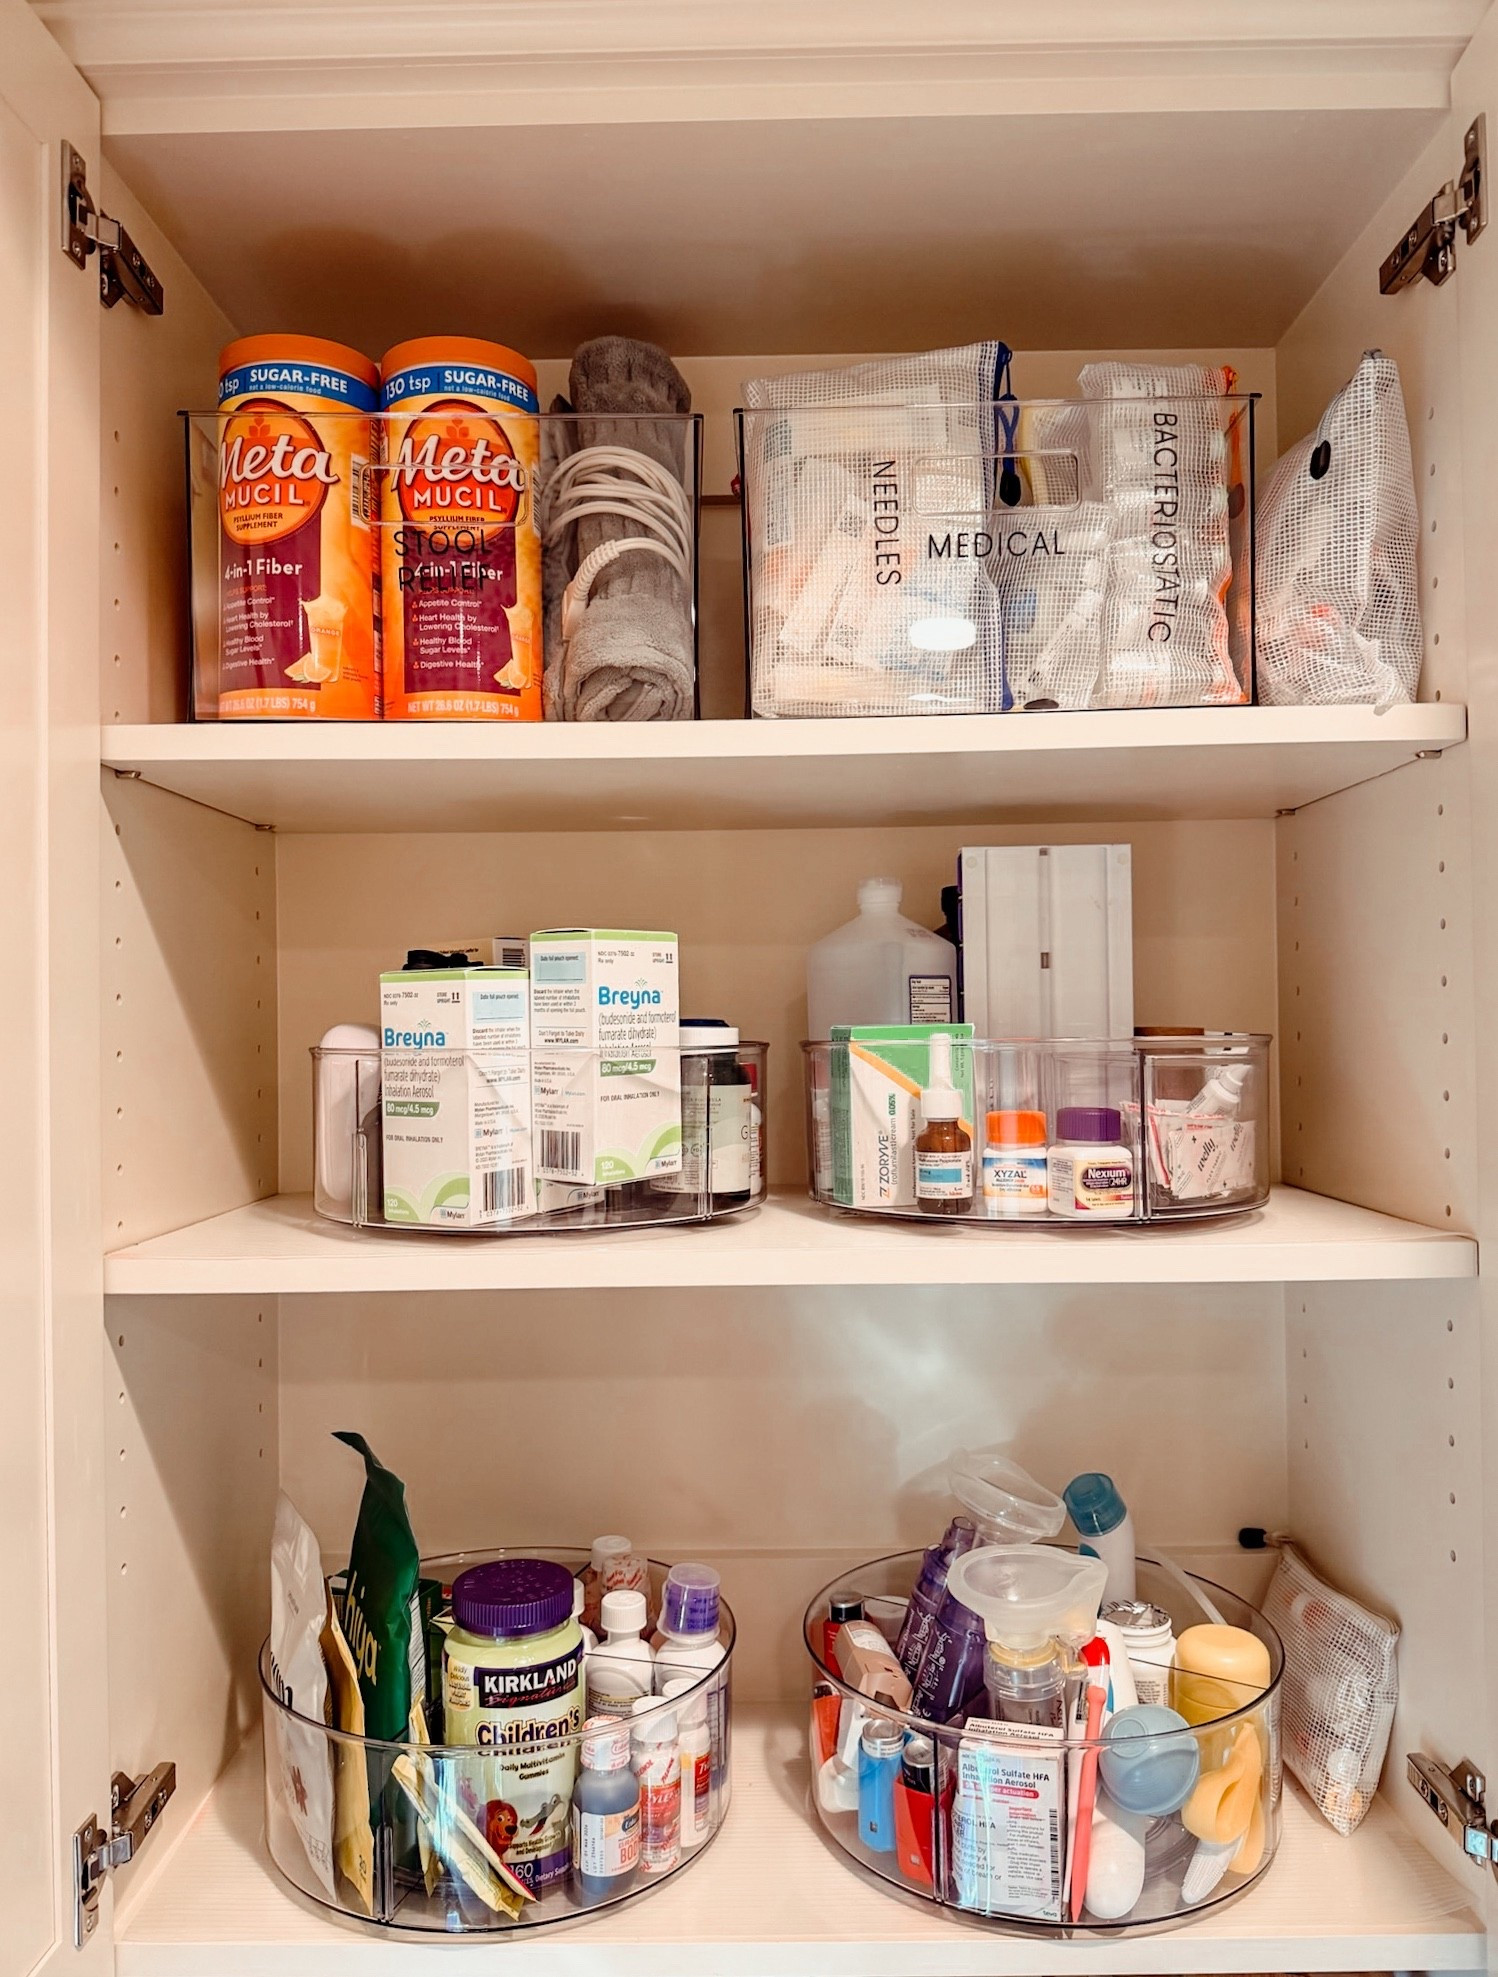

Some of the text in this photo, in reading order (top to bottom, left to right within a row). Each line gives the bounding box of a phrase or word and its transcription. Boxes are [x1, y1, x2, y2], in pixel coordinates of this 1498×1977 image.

[225, 378, 240, 396] tsp
[250, 368, 348, 394] SUGAR-FREE
[386, 375, 431, 401] 130 tsp
[444, 371, 529, 403] SUGAR-FREE
[221, 434, 341, 490] Meta
[391, 434, 526, 492] Meta
[225, 484, 305, 510] MUCIL
[413, 487, 503, 512] MUCIL
[263, 513, 284, 524] FIBER
[872, 460, 901, 585] NEEDLES
[235, 520, 279, 534] SUPPLEMENT
[1148, 412, 1182, 642] BACTERIOSTATIC
[394, 528, 493, 557] STOOL
[928, 531, 1064, 561] MEDICAL
[225, 556, 303, 580] 4-in-1 Fiber
[415, 560, 505, 581] 4-in-1 Fiber
[399, 565, 490, 592] RELIEF
[419, 599, 449, 609] Appetite
[419, 614, 478, 624] Heart Health by
[311, 627, 341, 637] ORANGE
[419, 622, 456, 633] Lowering
[419, 638, 446, 648] Healthy
[420, 648, 440, 657] Sugar
[421, 660, 453, 672] Digestive
[292, 697, 308, 710] 754
[598, 986, 661, 1010] Breyna
[637, 1012, 648, 1024] and
[384, 1027, 446, 1050] Breyna
[598, 1026, 657, 1041] fumarate dihydrate)
[418, 1055, 430, 1066] and
[431, 1054, 465, 1067] formoterol
[601, 1061, 611, 1070] 80
[639, 1063, 652, 1071] mcg
[384, 1084, 434, 1098] Inhalation Aerosol
[624, 1093, 649, 1101] INHALATION
[386, 1105, 434, 1116] 80 mcg/4.5 mcg
[889, 1093, 899, 1116] 0.05%
[890, 1117, 899, 1141] cream
[661, 1160, 677, 1168] Mylan
[878, 1135, 890, 1184] ZORYVE
[1087, 1168, 1126, 1179] Nexium
[1109, 1177, 1128, 1187] 24HR
[447, 1210, 465, 1219] Mylan
[344, 1570, 378, 1687] hiya
[484, 1658, 577, 1693] KIRKLAND
[485, 1677, 577, 1708] Signature
[476, 1706, 581, 1757] Children's
[1007, 1727, 1036, 1736] Sulfate
[520, 1752, 565, 1770] Multivitamin
[519, 1769, 549, 1781] Gummies
[1001, 1768, 1050, 1782] Sulfate HFA
[1004, 1778, 1036, 1788] Aerosol
[1002, 1788, 1036, 1798] actuation
